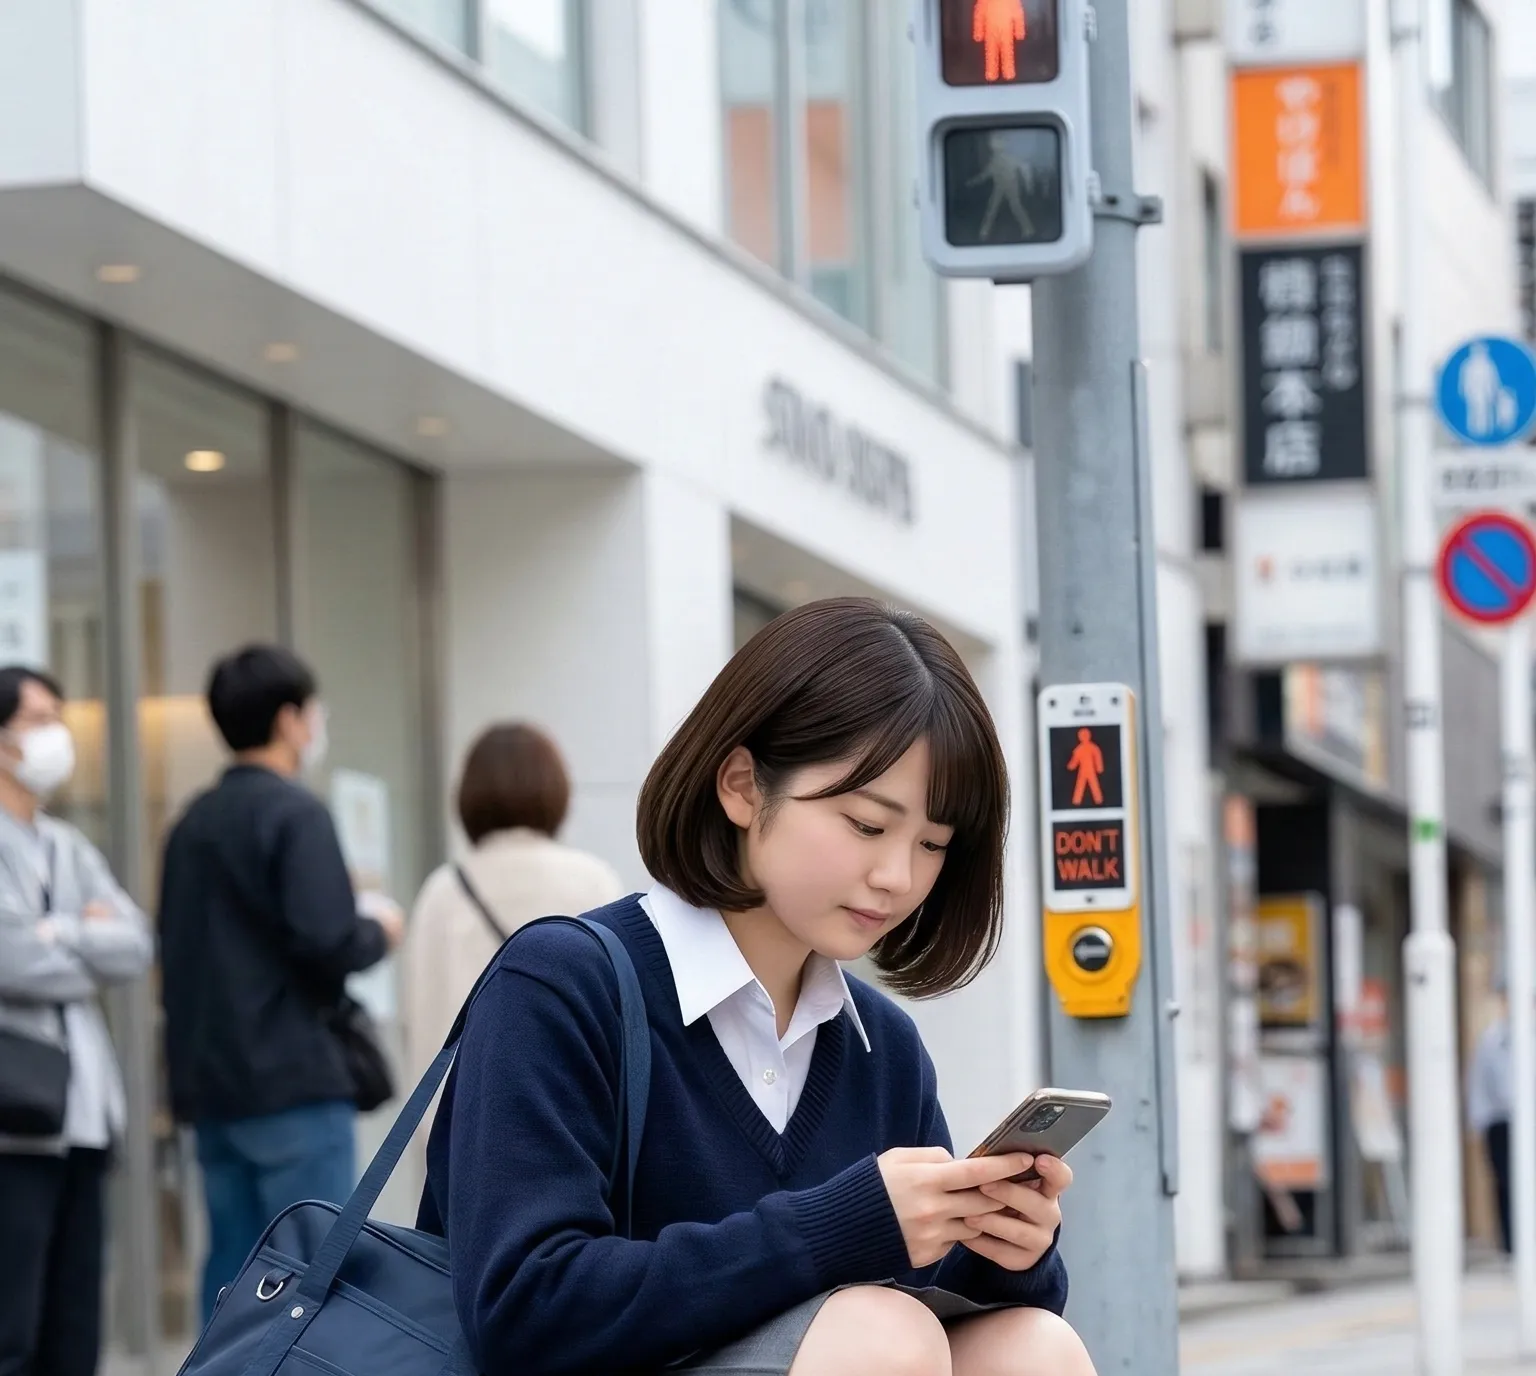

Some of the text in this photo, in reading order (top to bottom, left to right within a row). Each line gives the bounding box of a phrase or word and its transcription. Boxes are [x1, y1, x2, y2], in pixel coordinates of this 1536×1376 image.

[1258, 258, 1323, 477] 本店
[1055, 828, 1119, 855] DON'T
[1057, 857, 1119, 881] WALK
